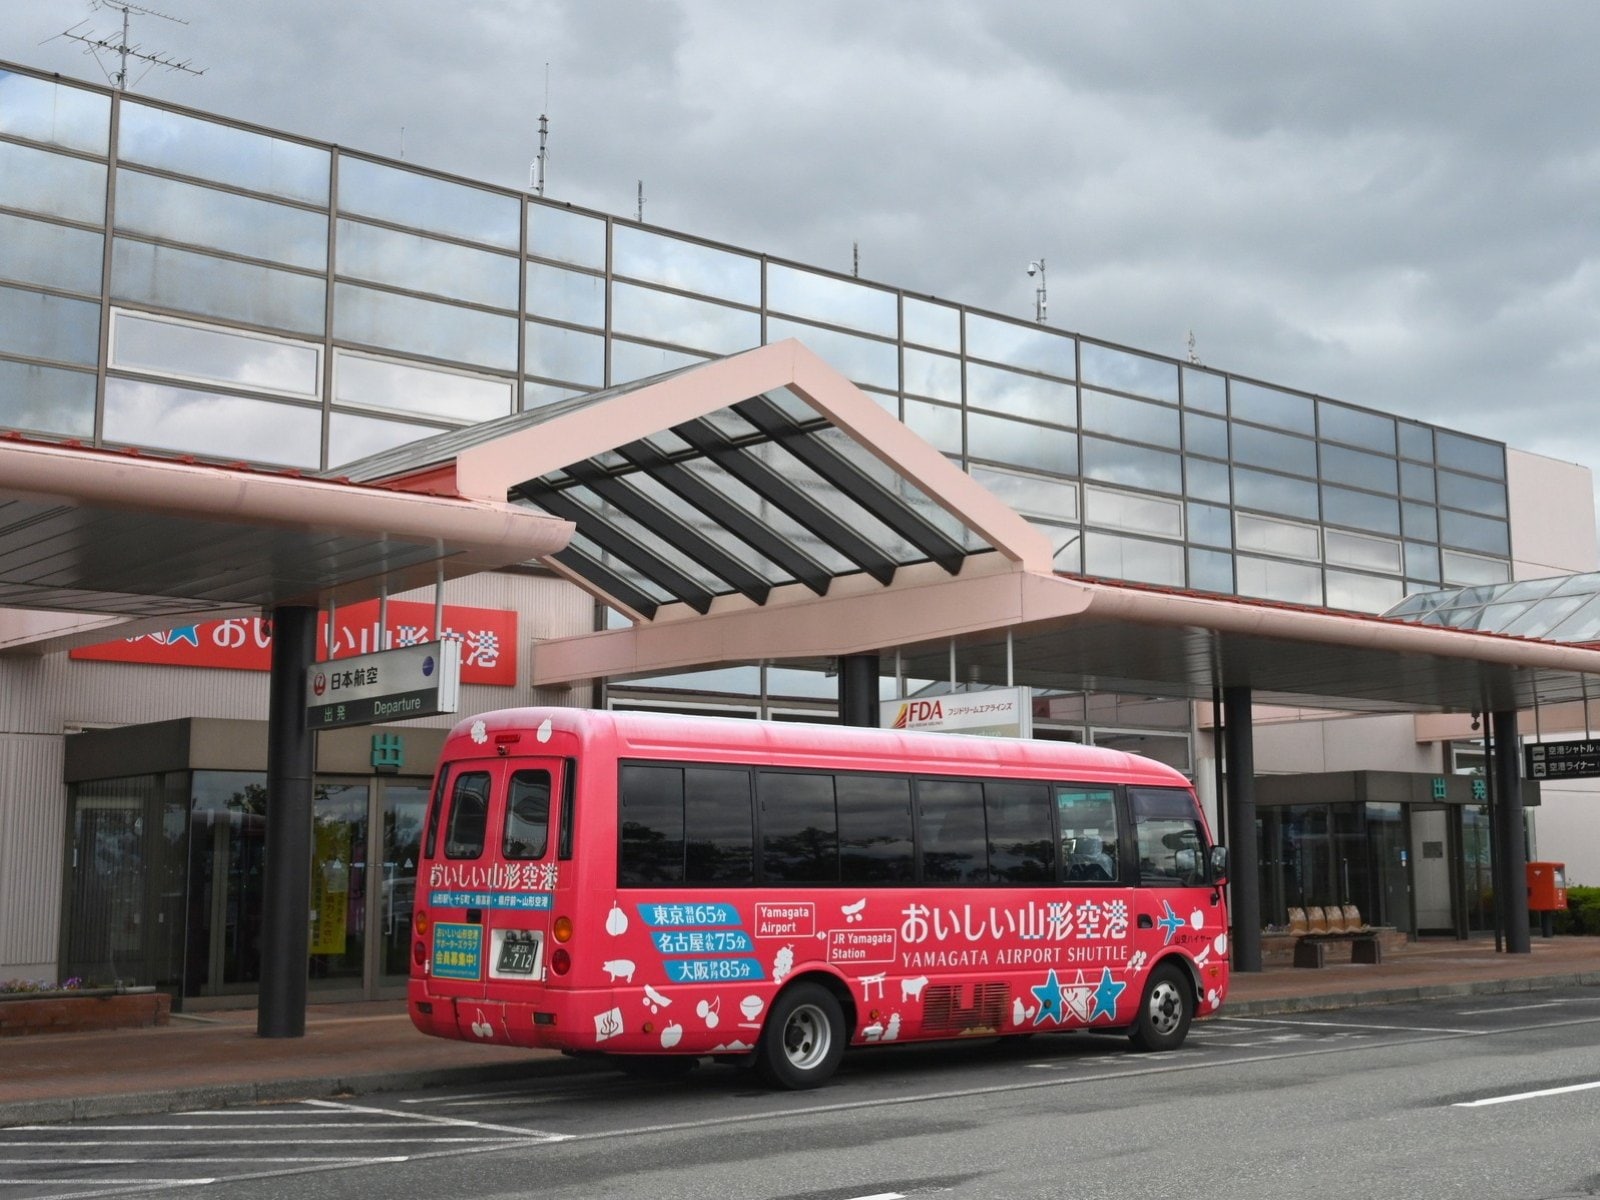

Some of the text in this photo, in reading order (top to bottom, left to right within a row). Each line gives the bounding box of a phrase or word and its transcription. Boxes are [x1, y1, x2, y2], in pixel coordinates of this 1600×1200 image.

[331, 666, 379, 691] 日本航空
[323, 697, 421, 722] 出発 Departure
[908, 700, 943, 722] FDA
[948, 702, 1013, 716] フジドリームエアラインズ
[371, 732, 405, 768] 出
[430, 862, 558, 890] おいしい山形空港
[760, 906, 810, 919] Yamagata
[900, 899, 1129, 943] おいしい山形空港
[760, 922, 797, 934] Airport
[832, 932, 893, 946] JR Yamagata
[831, 948, 866, 959] Station
[902, 945, 1128, 968] YAMAGATA AIRPORT SHUTTLE
